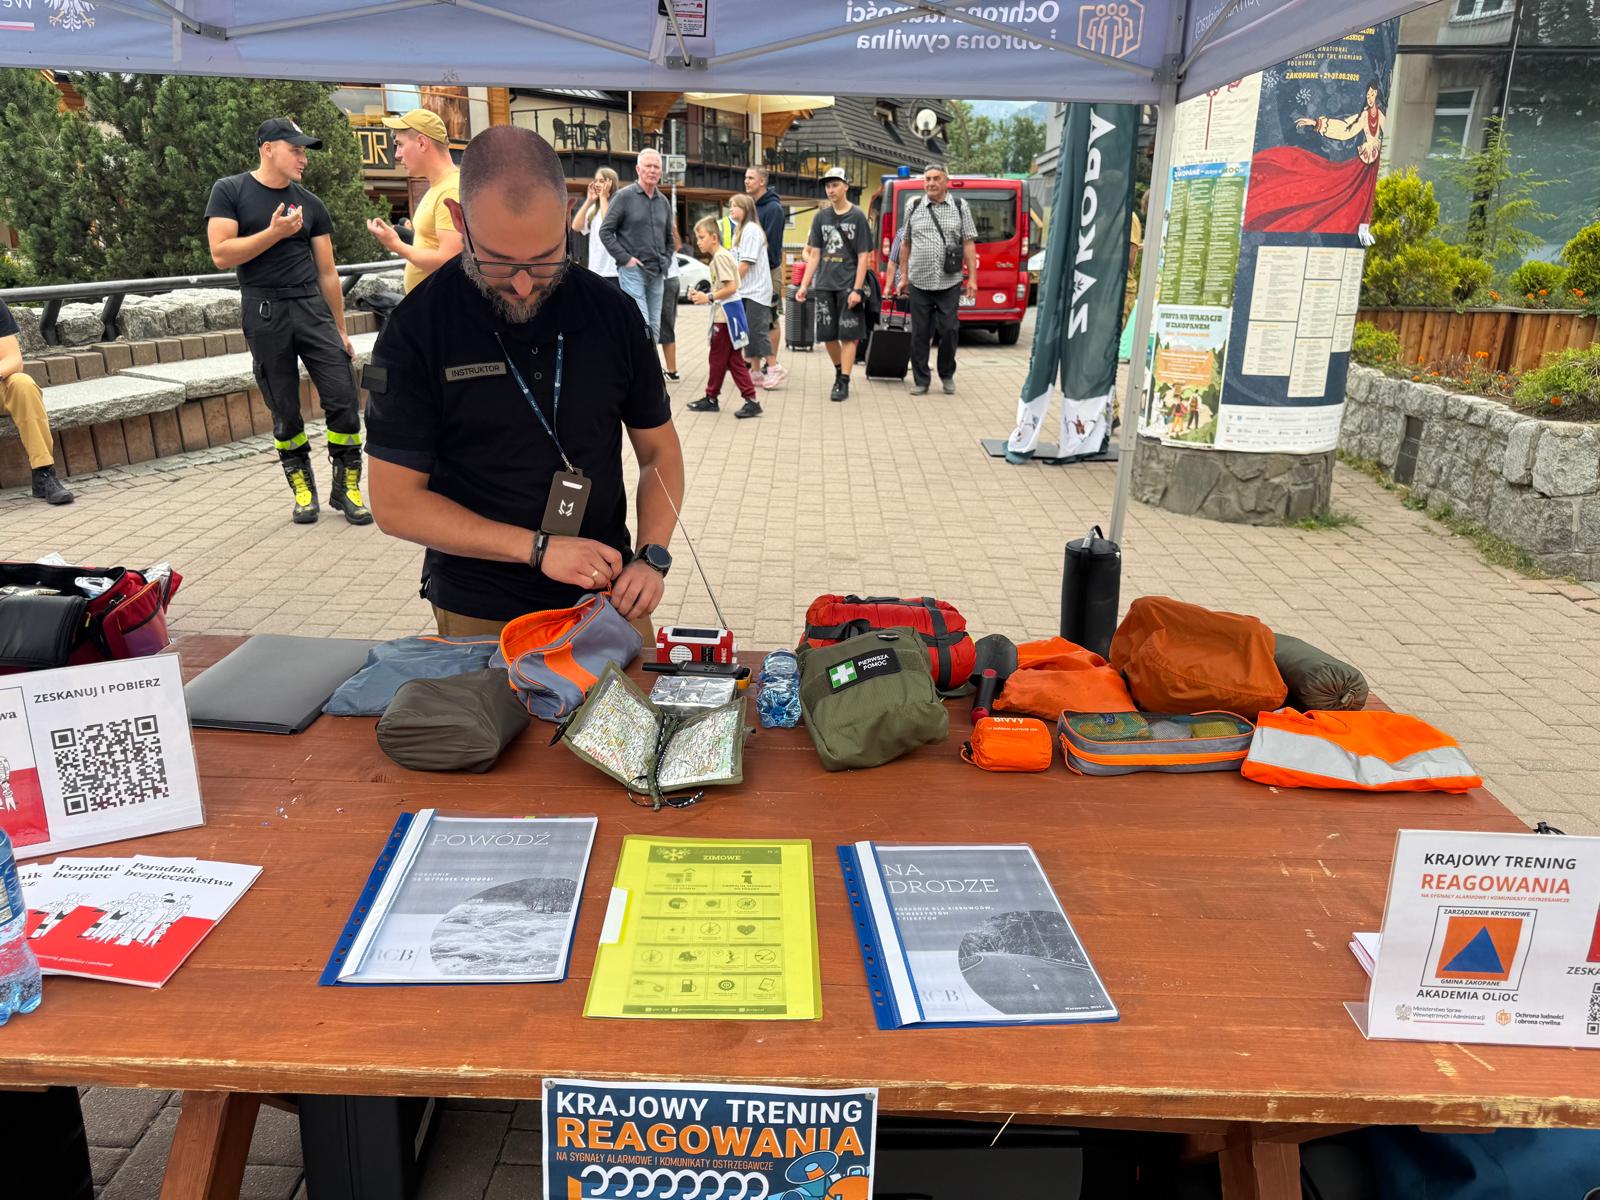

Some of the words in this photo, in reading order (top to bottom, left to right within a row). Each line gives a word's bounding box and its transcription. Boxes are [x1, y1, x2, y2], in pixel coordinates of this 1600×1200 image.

[1285, 72, 1319, 80] ZAKOPANE
[352, 131, 388, 164] OR
[451, 364, 500, 378] INSTRUKTOR
[858, 654, 890, 667] PIERWSZA
[863, 660, 888, 671] POMOC
[33, 685, 98, 704] ZESKANUJ
[108, 678, 161, 693] POBIERZ
[432, 832, 552, 847] POWÓDŹ
[59, 864, 123, 872] Poradni
[132, 862, 197, 875] Poradnik
[1424, 853, 1501, 868] KRAJOWY
[1505, 855, 1577, 870] TRENING
[52, 871, 112, 881] bezpiec
[883, 864, 925, 876] NA
[124, 870, 234, 888] bezpieczeństwa
[890, 878, 999, 894] DRODZE
[1420, 873, 1571, 895] REAGOWANIA
[1443, 909, 1489, 917] ZARZĄDZANIE
[1491, 910, 1532, 918] KRYZYSOWE
[1440, 978, 1464, 986] GMINA
[1464, 979, 1500, 987] ZAKOPANE
[1416, 989, 1479, 1001] AKADEMIA
[556, 1091, 709, 1121] KRAJOWY
[725, 1099, 863, 1124] TRENING
[556, 1117, 865, 1159] REAGOWANIA
[556, 1152, 567, 1162] NA
[569, 1152, 605, 1164] SYGNAŁY
[607, 1155, 653, 1166] ALARMOWE
[659, 1157, 710, 1169] KOMUNIKATY
[712, 1159, 774, 1171] OSTRZEGAWCZE
